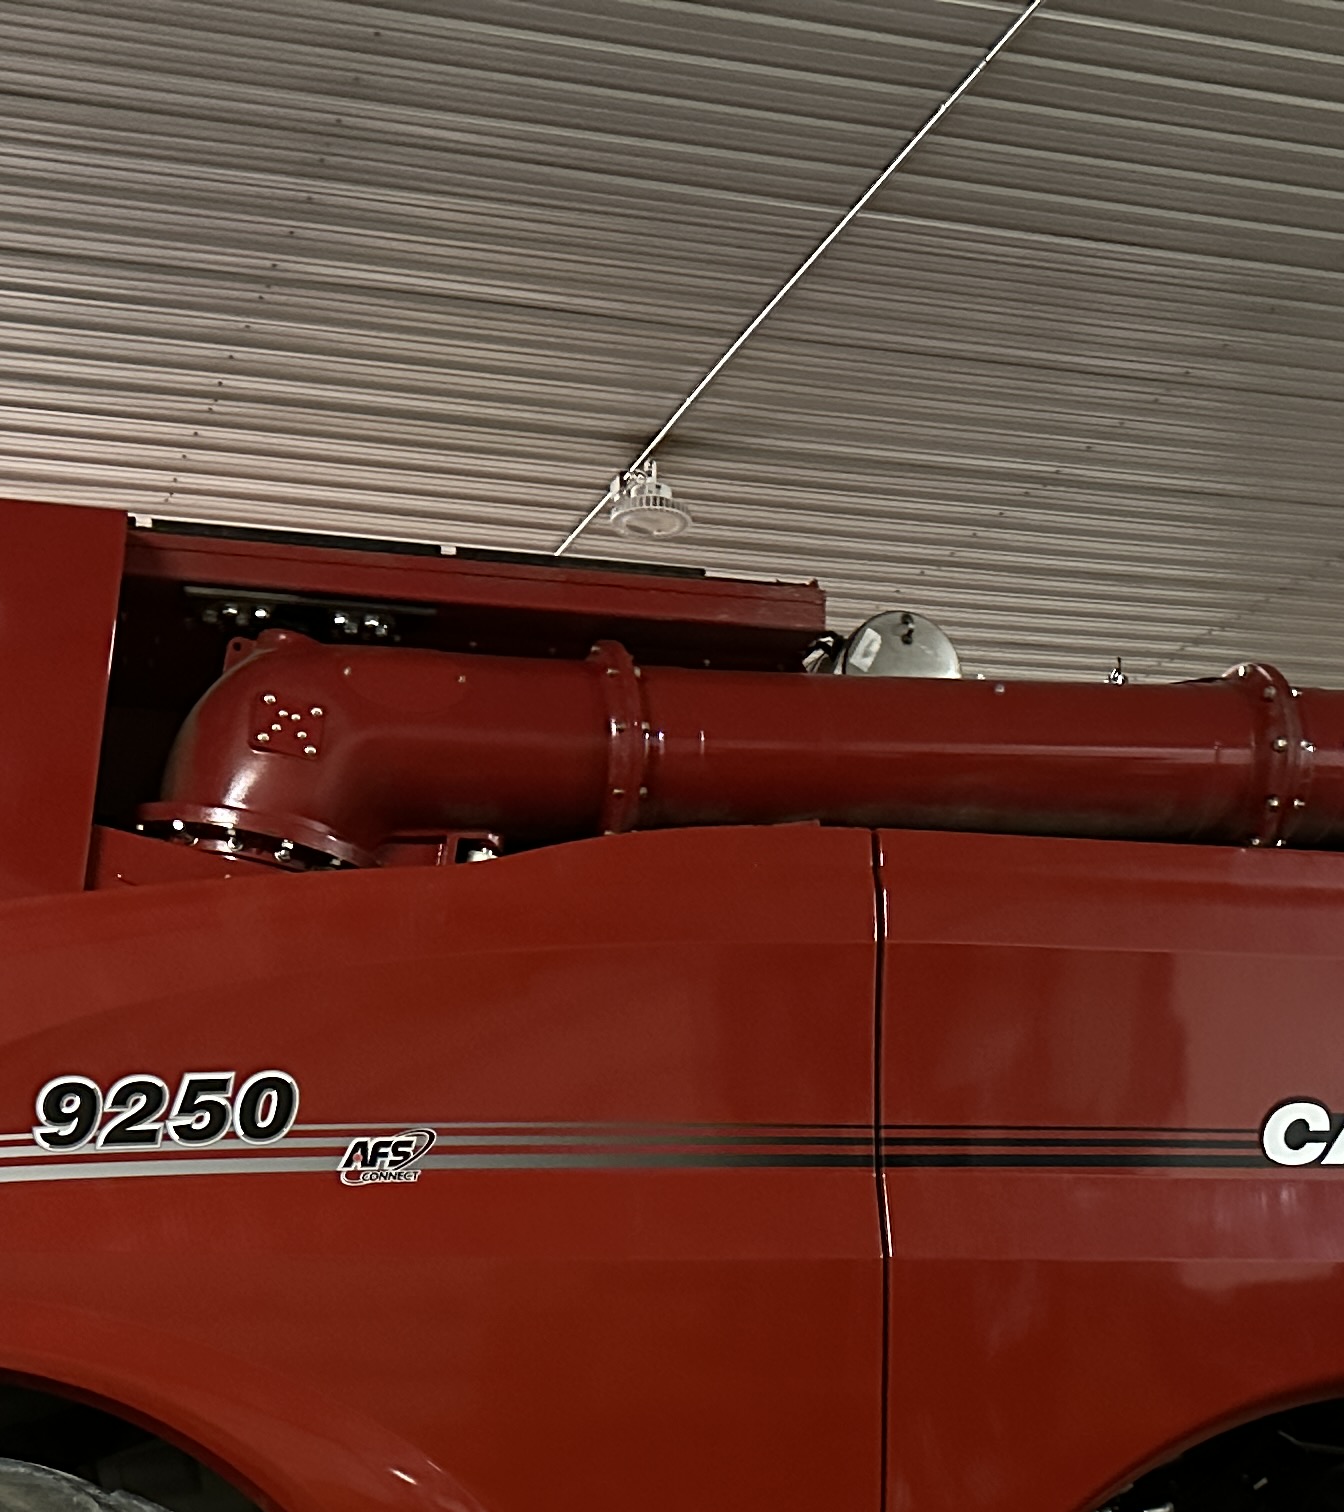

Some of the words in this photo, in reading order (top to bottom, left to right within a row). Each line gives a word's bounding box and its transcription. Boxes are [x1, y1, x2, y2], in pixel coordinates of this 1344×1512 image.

[33, 1070, 300, 1152] 9250
[337, 1136, 418, 1171] AFS
[360, 1169, 422, 1183] CONNECT
